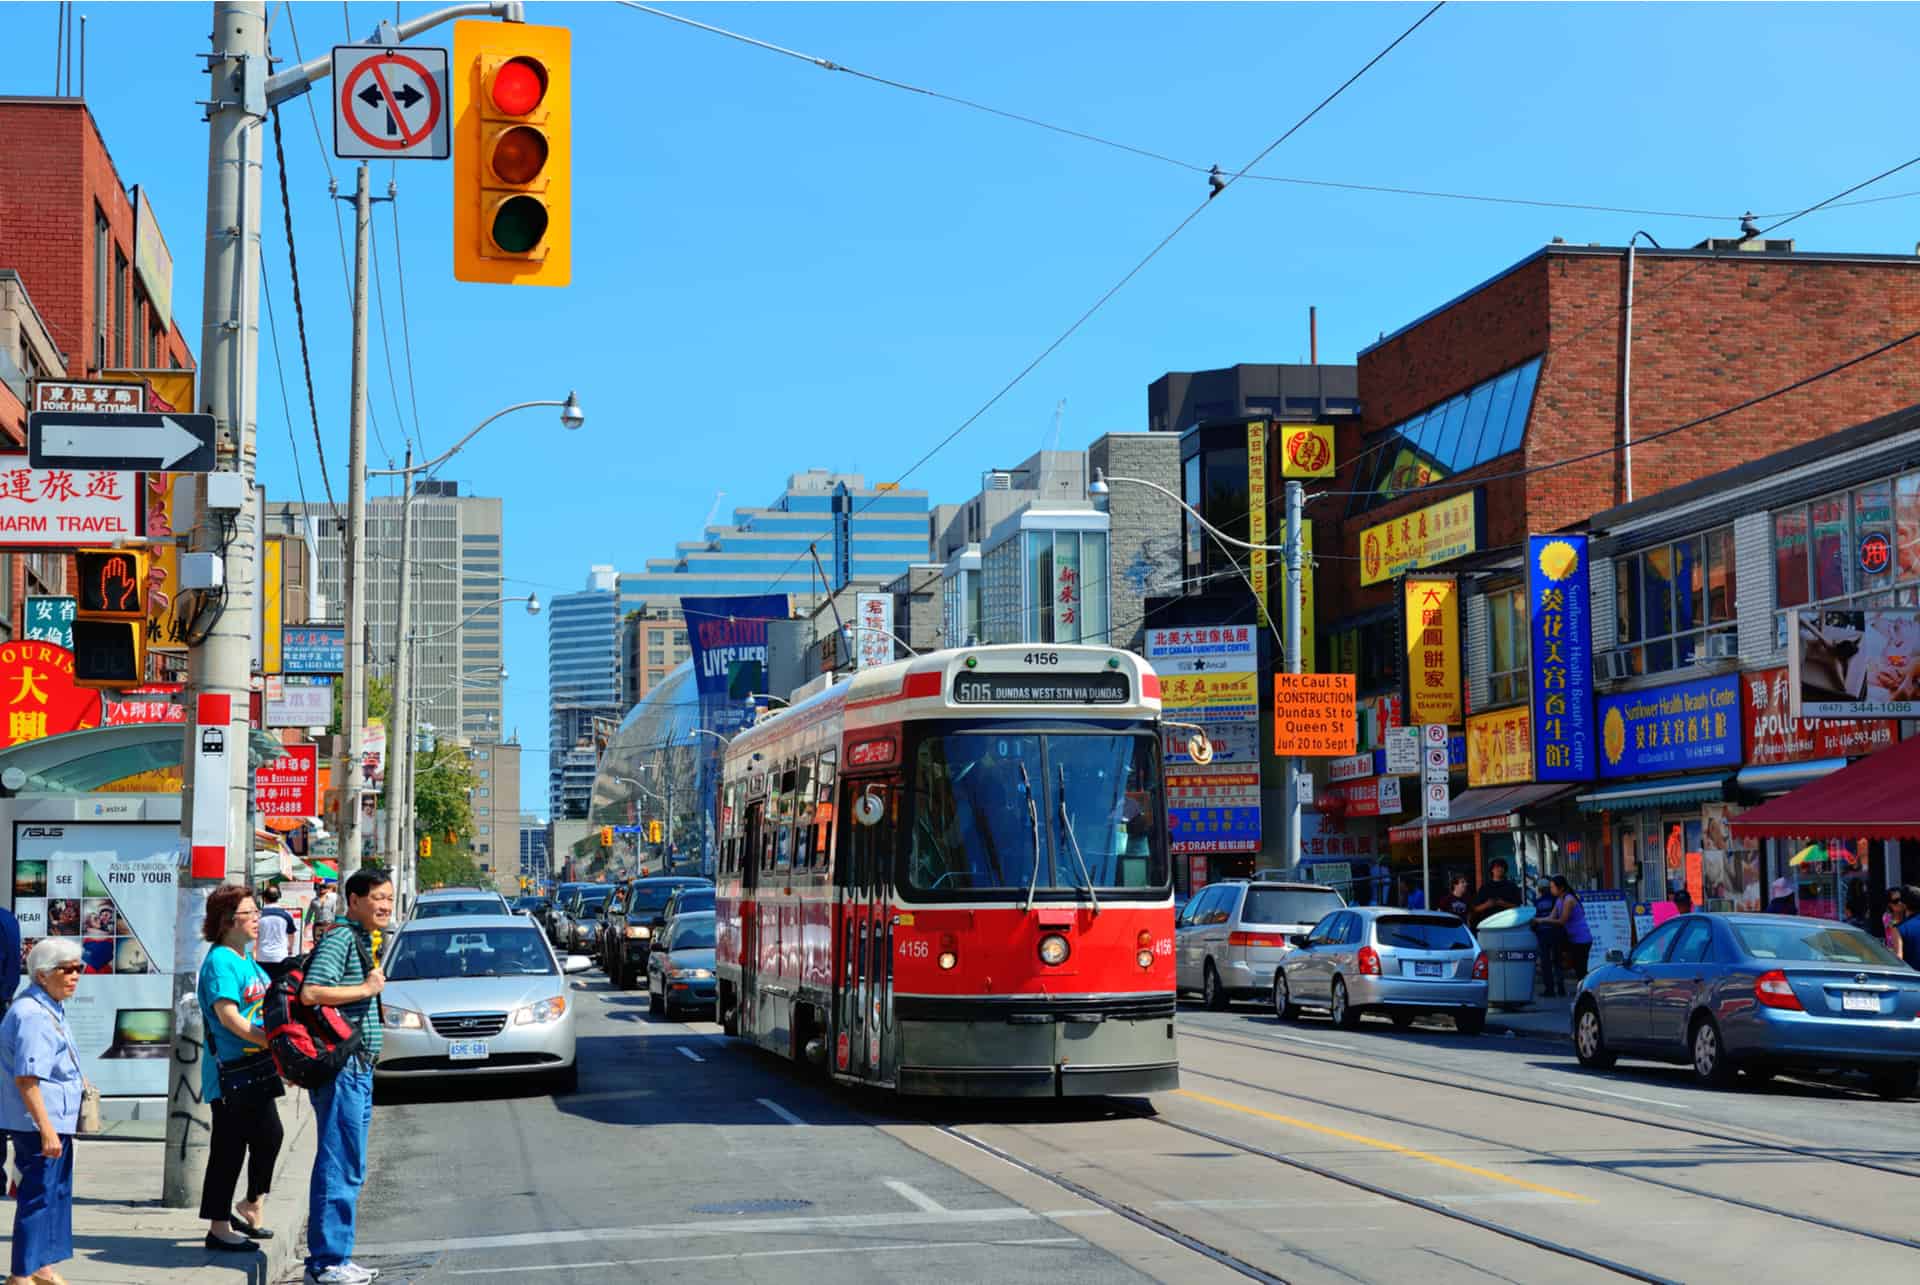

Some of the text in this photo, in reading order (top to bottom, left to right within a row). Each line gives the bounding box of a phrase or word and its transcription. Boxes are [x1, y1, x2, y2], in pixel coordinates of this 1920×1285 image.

[43, 401, 69, 410] TONY
[72, 402, 95, 412] HAIR
[56, 515, 128, 532] TRAVEL
[1568, 584, 1581, 644] Sunflower
[698, 618, 768, 649] CREATIVIT
[703, 647, 735, 678] LIVES
[1023, 653, 1059, 665] 4156
[1335, 676, 1347, 688] St
[960, 683, 1123, 702] 505 DUNDAS WEST STN VIA DUNDAS
[1277, 692, 1353, 704] CONSTRUCTION
[1416, 691, 1456, 700] CHINESE
[1277, 706, 1352, 718] Dundas St to
[1417, 701, 1453, 711] BAKERY
[1818, 702, 1913, 713] (647) 344-1086
[1286, 721, 1344, 733] Queen St
[1278, 738, 1294, 750] Jun
[1298, 738, 1310, 750] 20
[1312, 738, 1322, 750] to
[1324, 737, 1347, 752] Sept
[22, 827, 65, 837] ASUS
[56, 875, 73, 884] SEE
[108, 872, 172, 883] FIND YOUR
[17, 912, 41, 922] HEAR
[899, 941, 929, 958] 4156
[1155, 939, 1172, 955] 4156
